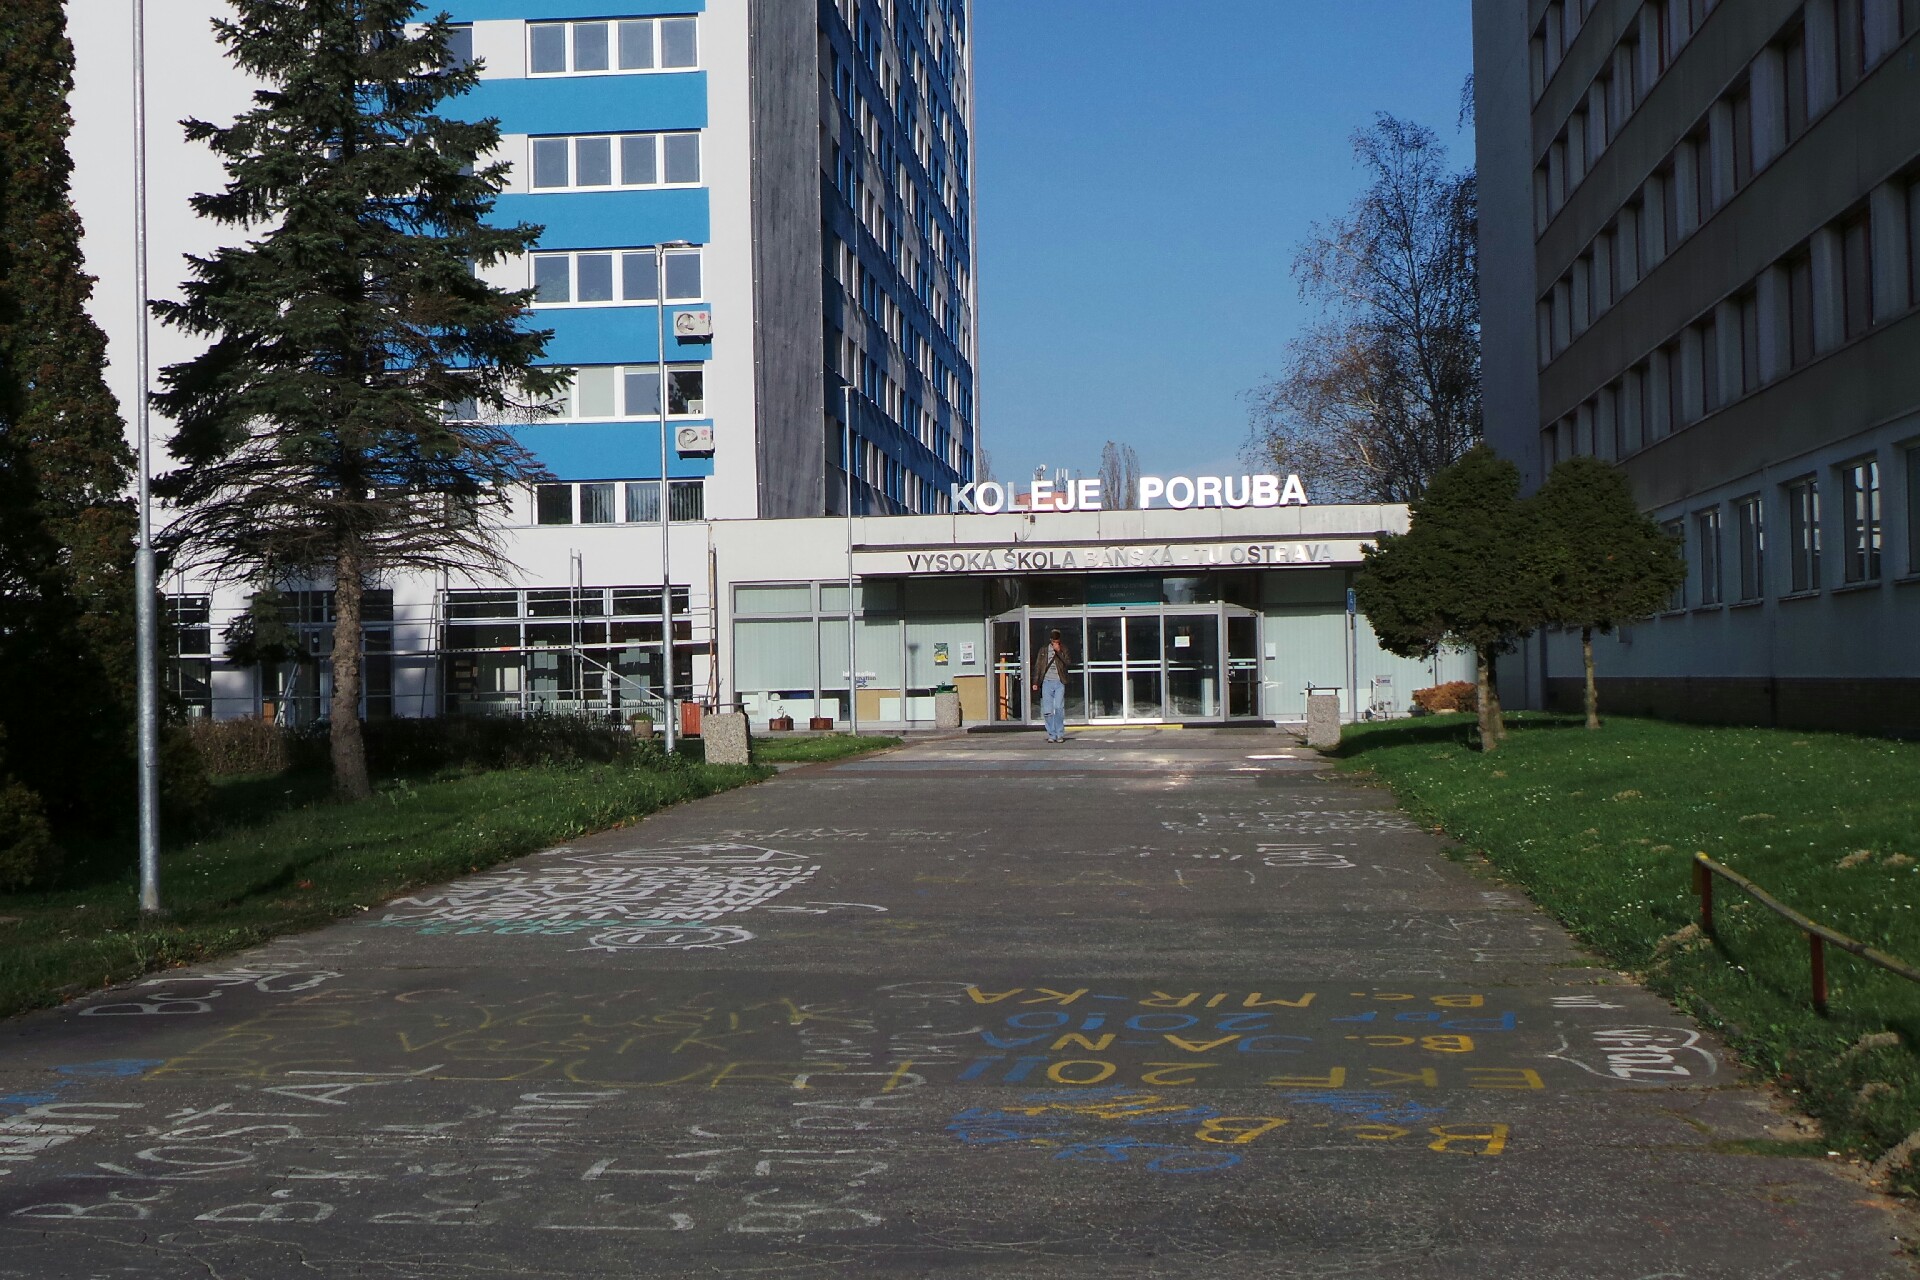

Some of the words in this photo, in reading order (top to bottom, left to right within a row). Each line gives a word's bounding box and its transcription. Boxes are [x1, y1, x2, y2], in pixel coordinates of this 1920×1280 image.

[951, 479, 1101, 514] KOLEJE
[1139, 475, 1308, 509] PORUBA
[907, 549, 997, 572] VYSOKÁ
[1002, 548, 1077, 570] ŠKOLA
[1230, 544, 1334, 564] OSTRAVA
[1262, 1067, 1546, 1089] EKF
